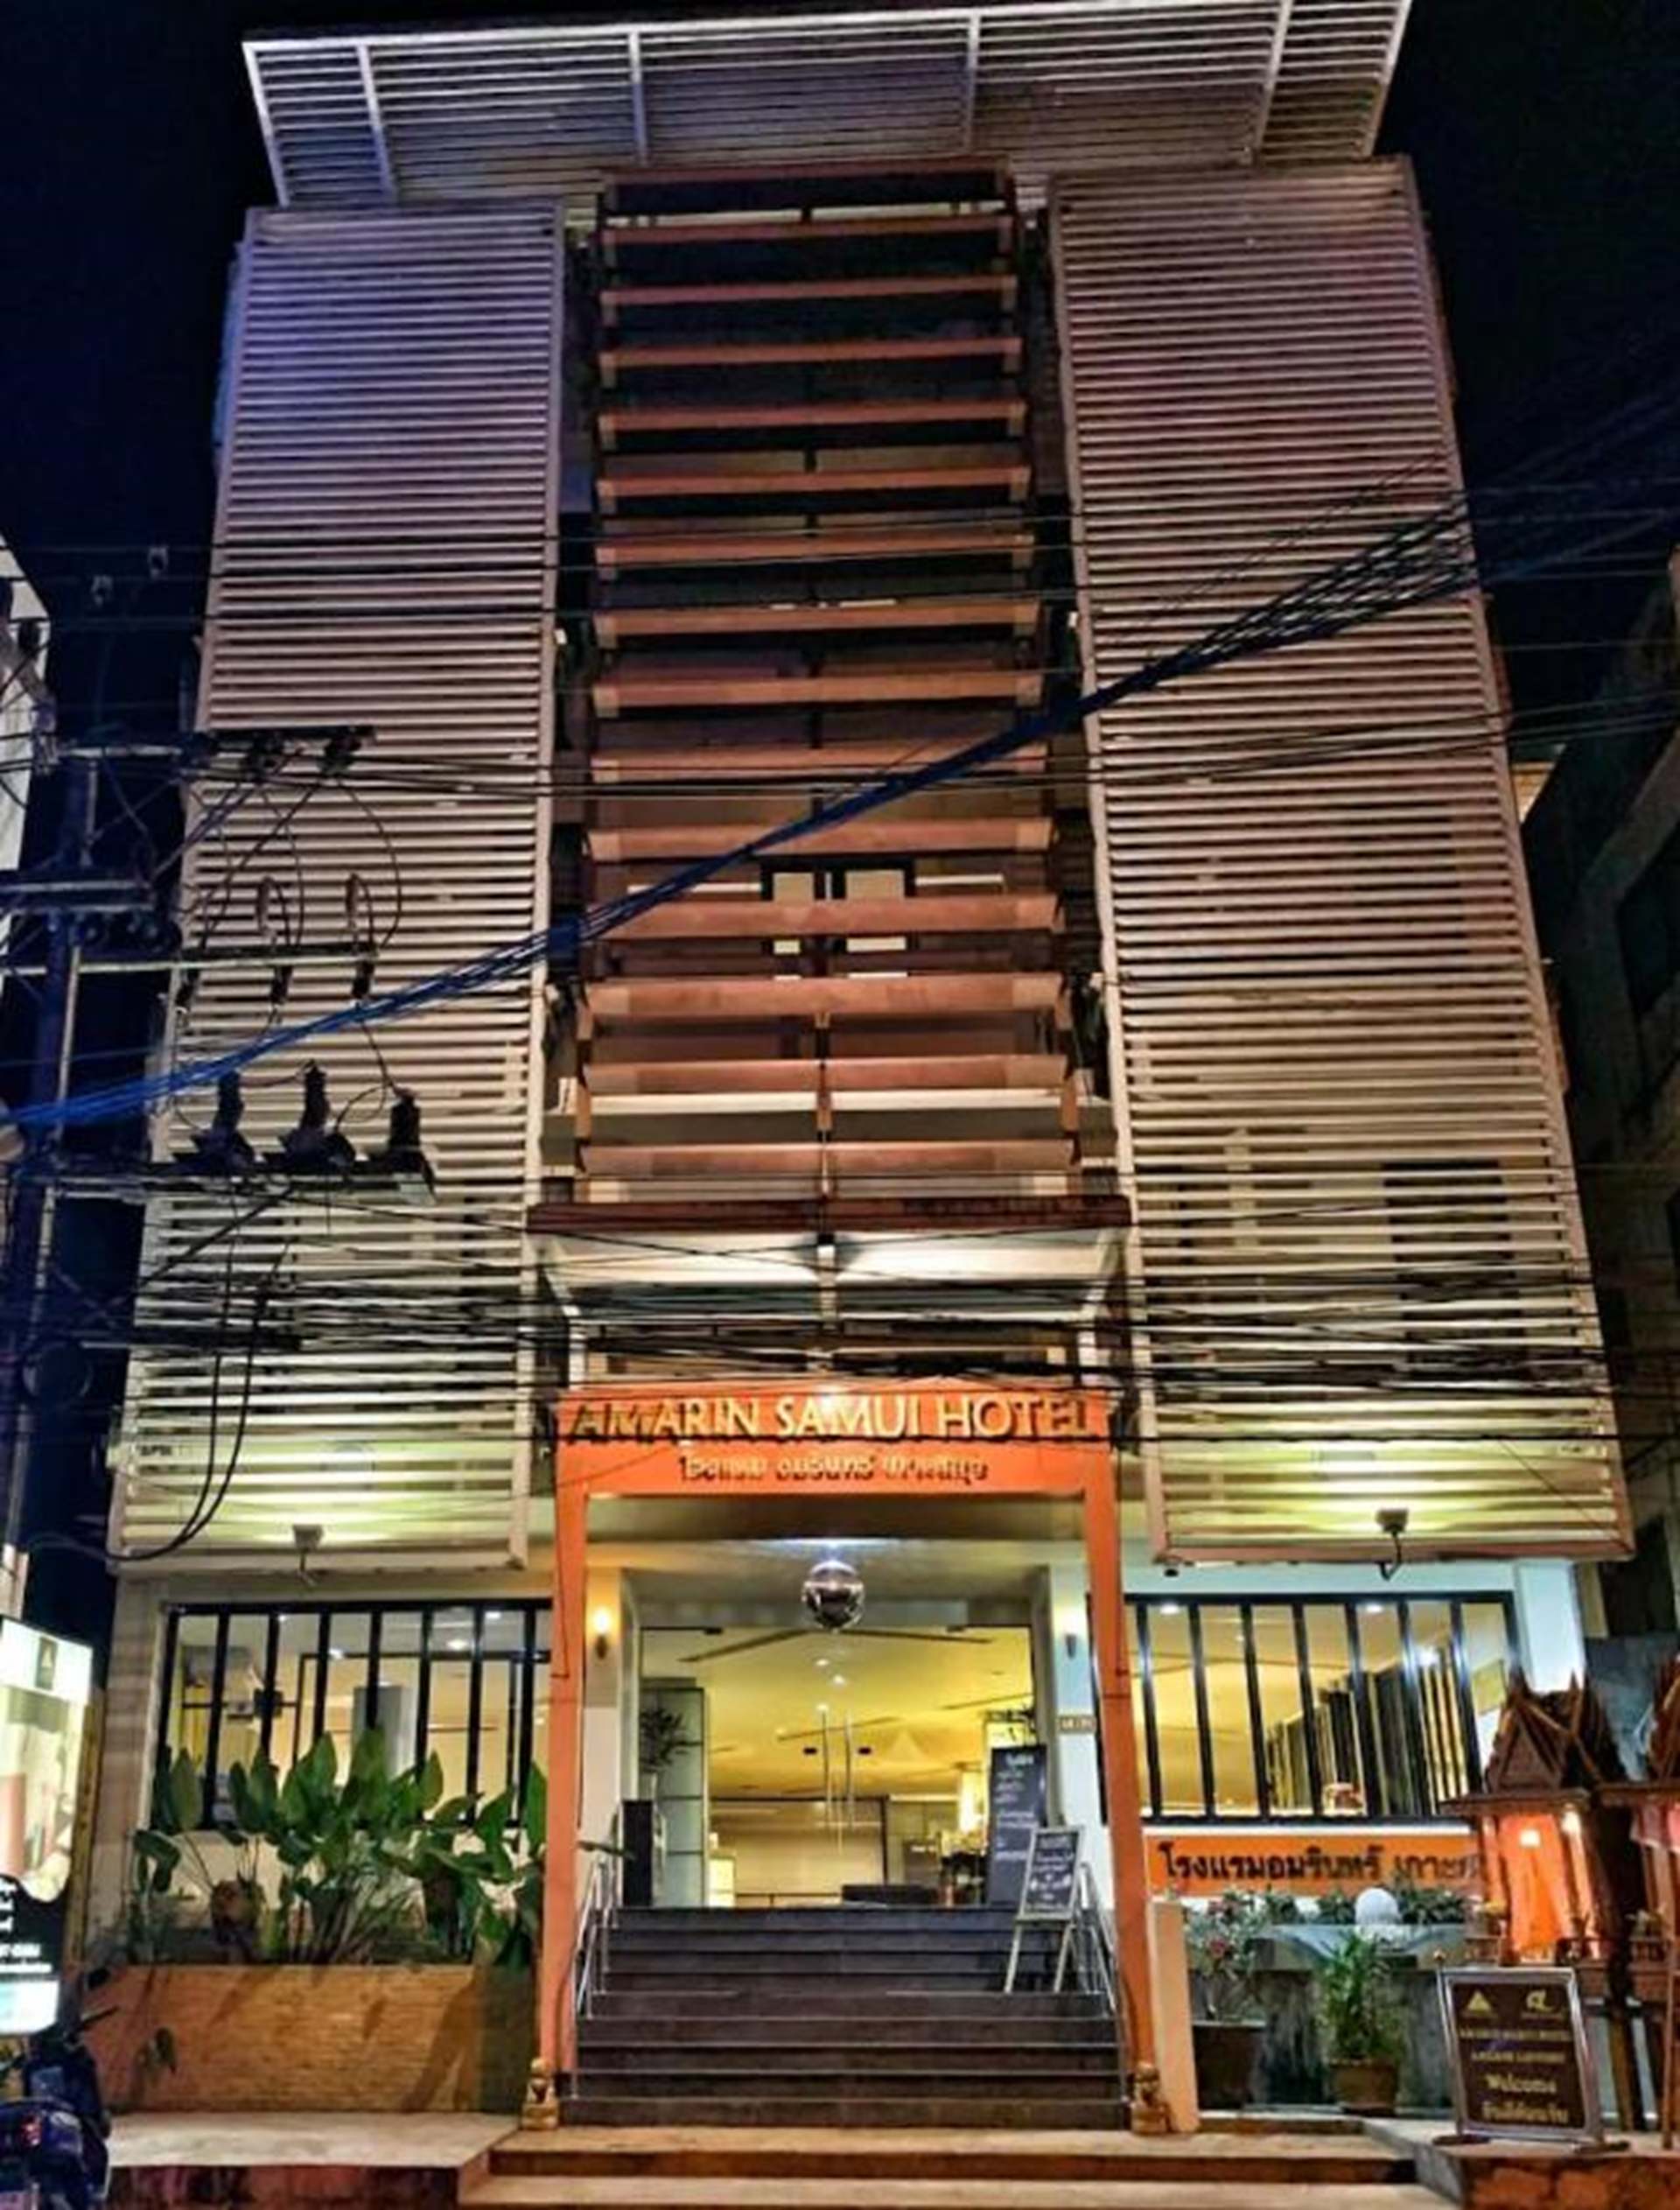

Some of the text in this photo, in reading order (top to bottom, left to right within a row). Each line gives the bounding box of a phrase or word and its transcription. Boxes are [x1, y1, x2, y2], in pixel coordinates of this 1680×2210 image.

[571, 1396, 1088, 1440] AMARIN SAMUI HOTEL
